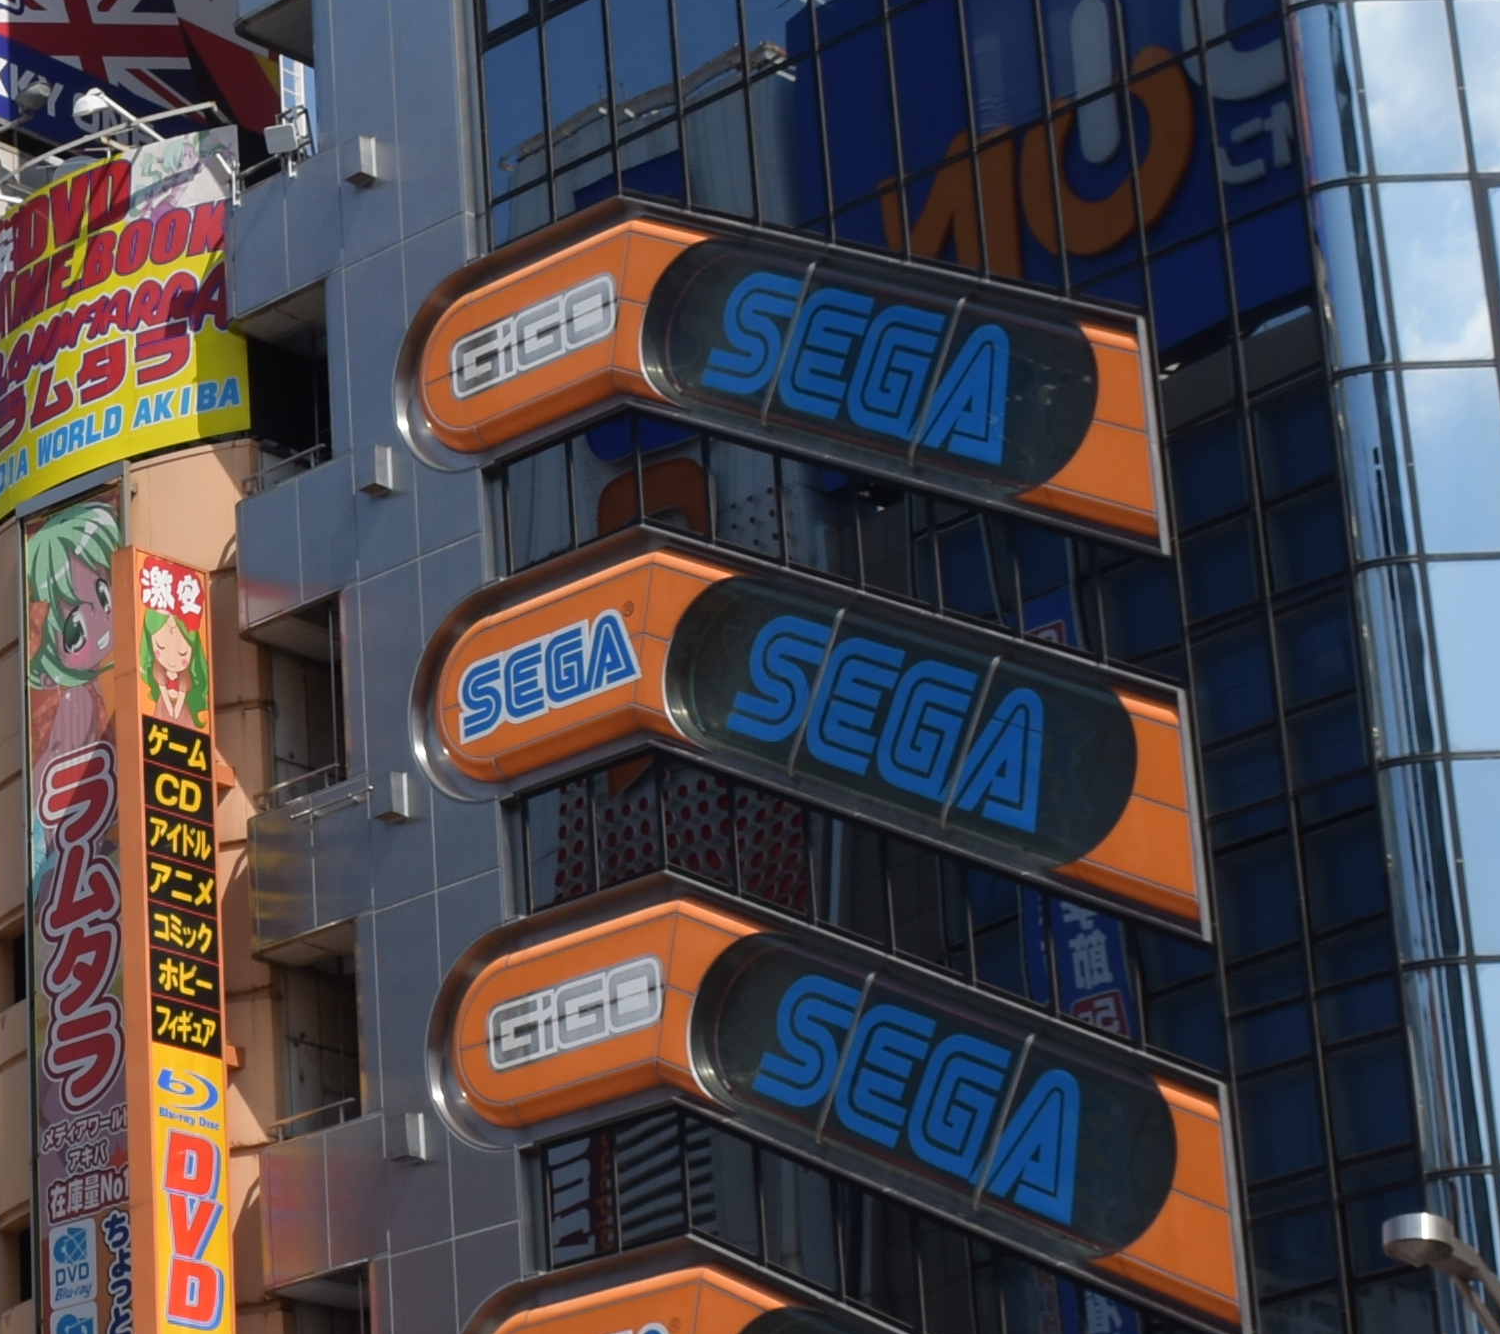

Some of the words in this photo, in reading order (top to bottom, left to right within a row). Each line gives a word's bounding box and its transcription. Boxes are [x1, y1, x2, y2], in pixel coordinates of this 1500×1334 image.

[452, 273, 616, 400] GiGO
[700, 269, 1011, 467] SEGA
[36, 404, 123, 469] WORLD
[132, 376, 242, 430] AKIBA
[138, 564, 204, 615] 激安
[459, 607, 641, 744] SEGA
[726, 610, 1046, 834] SEGA
[147, 724, 208, 771] ゲーム
[154, 773, 201, 813] CD
[149, 814, 212, 862] アイドル
[149, 862, 213, 908] アニメ
[40, 748, 127, 1110] ラムタラ
[153, 912, 212, 954] コミック
[157, 959, 213, 998] ホビー
[155, 1002, 217, 1049] フィギュア
[488, 954, 665, 1071] GiGO
[752, 971, 1081, 1226] SEGA
[163, 1127, 224, 1332] DVD
[55, 1262, 90, 1285] DVD
